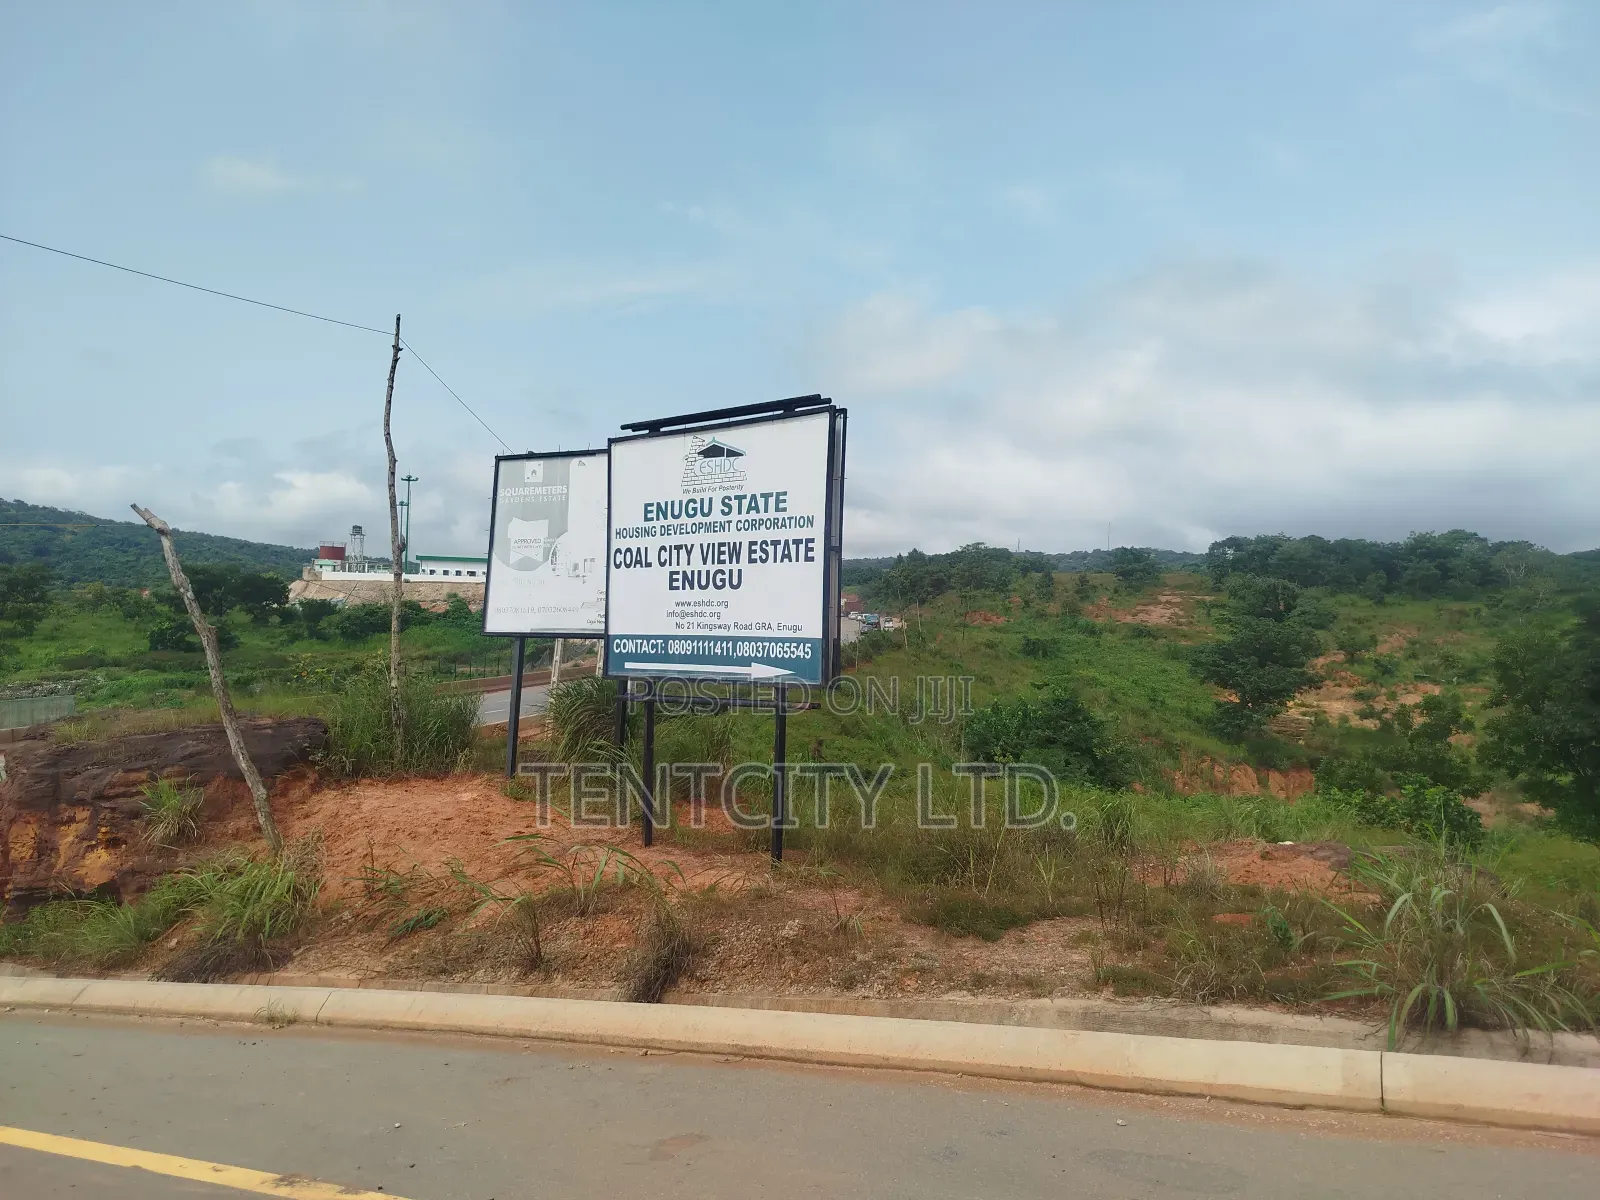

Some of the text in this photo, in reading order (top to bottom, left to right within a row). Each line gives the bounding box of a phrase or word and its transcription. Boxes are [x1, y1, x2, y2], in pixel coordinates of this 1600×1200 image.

[699, 457, 740, 475] ESHDC
[500, 485, 568, 497] SQUAREMETERS
[692, 486, 707, 494] Build
[707, 485, 717, 493] For
[718, 483, 745, 492] Posterity
[499, 494, 566, 504] GARDENS ESTATE
[643, 491, 788, 523] ENUGU STATE
[615, 514, 815, 540] HOUSING DEVELOPMENT CORPORATION
[613, 537, 816, 570] COAL CITY VIEW ESTATE
[668, 568, 743, 591] ENUGU
[675, 599, 729, 609] www.eshdc.org
[666, 609, 721, 620] info@eshdc.org
[675, 621, 803, 633] No 21 Kingsway Road GRA, Enugu
[613, 638, 812, 660] CONTACT: 08091111411,08037065545
